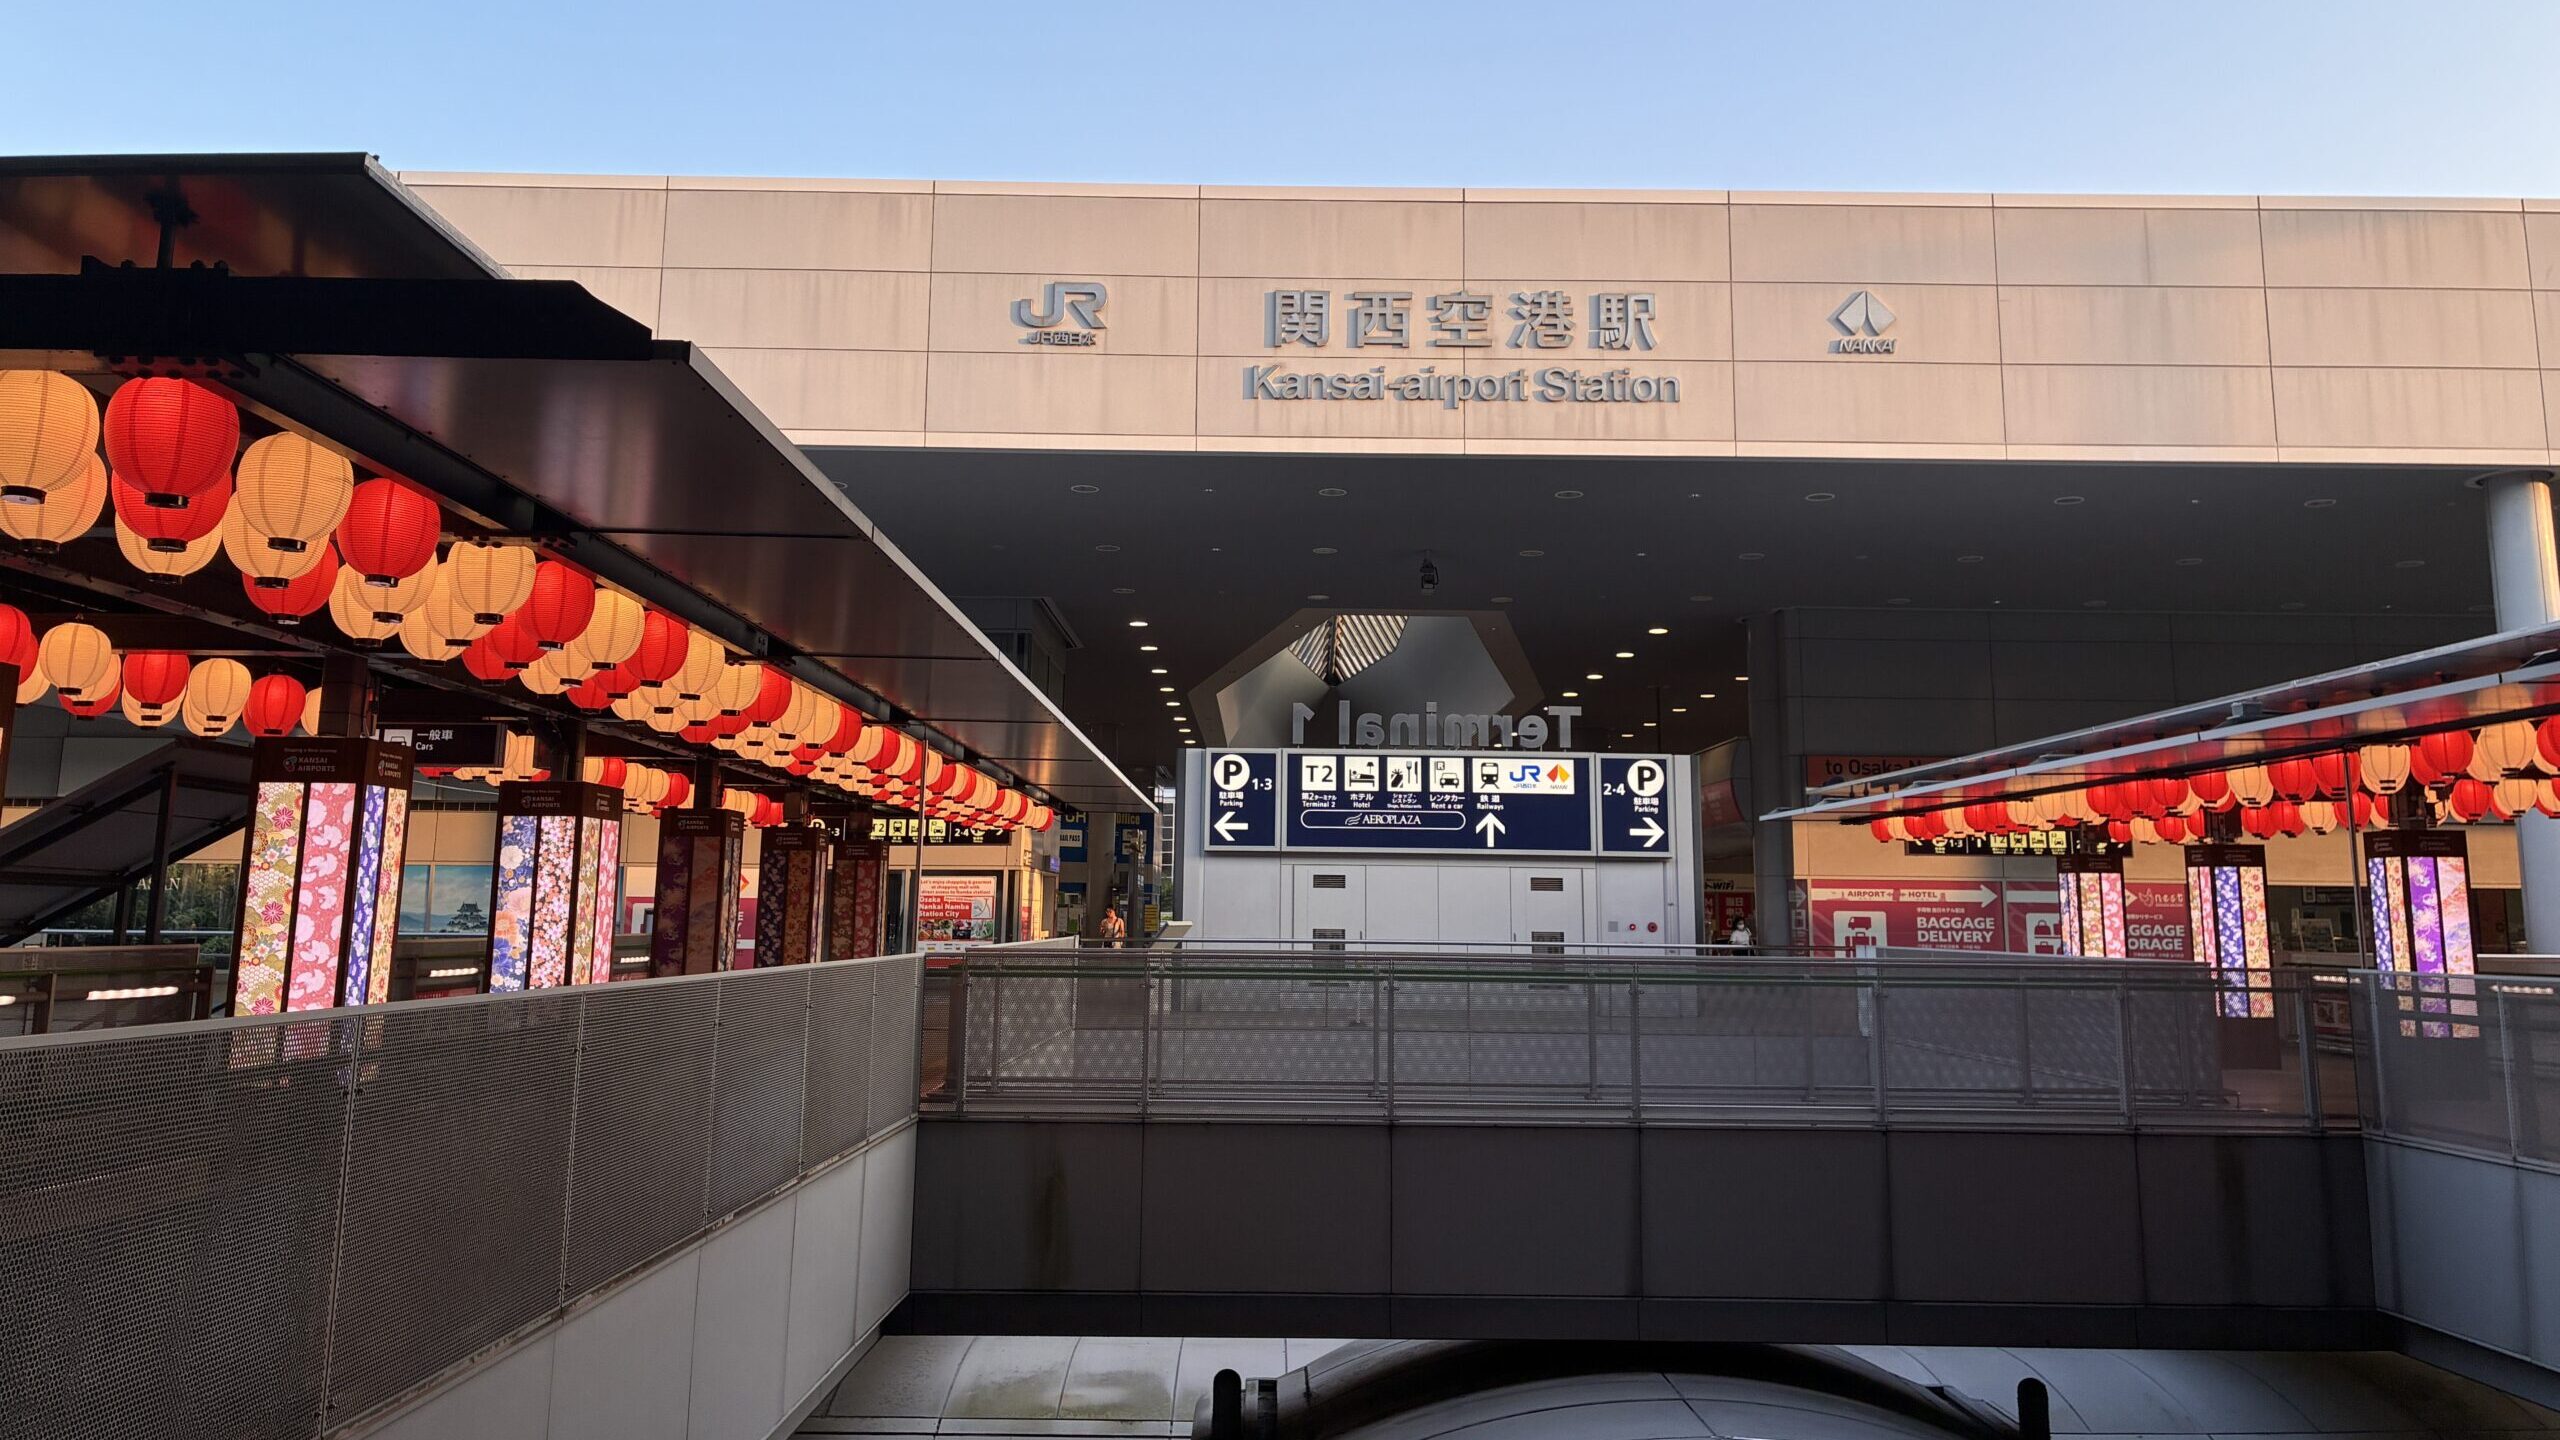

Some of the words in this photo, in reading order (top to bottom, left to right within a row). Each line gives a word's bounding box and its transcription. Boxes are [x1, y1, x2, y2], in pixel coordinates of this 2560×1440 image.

[1017, 282, 1107, 329] JR
[1272, 290, 1659, 350] 関西空港駅
[1026, 331, 1097, 346] JR西日本
[1248, 365, 1529, 409] Kansai-airport
[1541, 366, 1681, 402] Station
[416, 729, 454, 741] 一般車
[415, 741, 434, 751] Cars
[1825, 759, 1843, 775] to
[1509, 765, 1541, 783] JR
[1350, 793, 1375, 801] ホテル
[1430, 794, 1466, 802] レンタカー
[1219, 800, 1244, 808] Parking
[1634, 806, 1659, 814] Parking
[1362, 814, 1421, 825] AEROPLAZA
[1847, 890, 1885, 898] AIRPORT
[1916, 916, 1995, 929] BAGGAGE
[1917, 930, 1993, 943] DELIVERY
[2128, 924, 2185, 937] GGAGE
[2127, 938, 2184, 950] ORAGE
